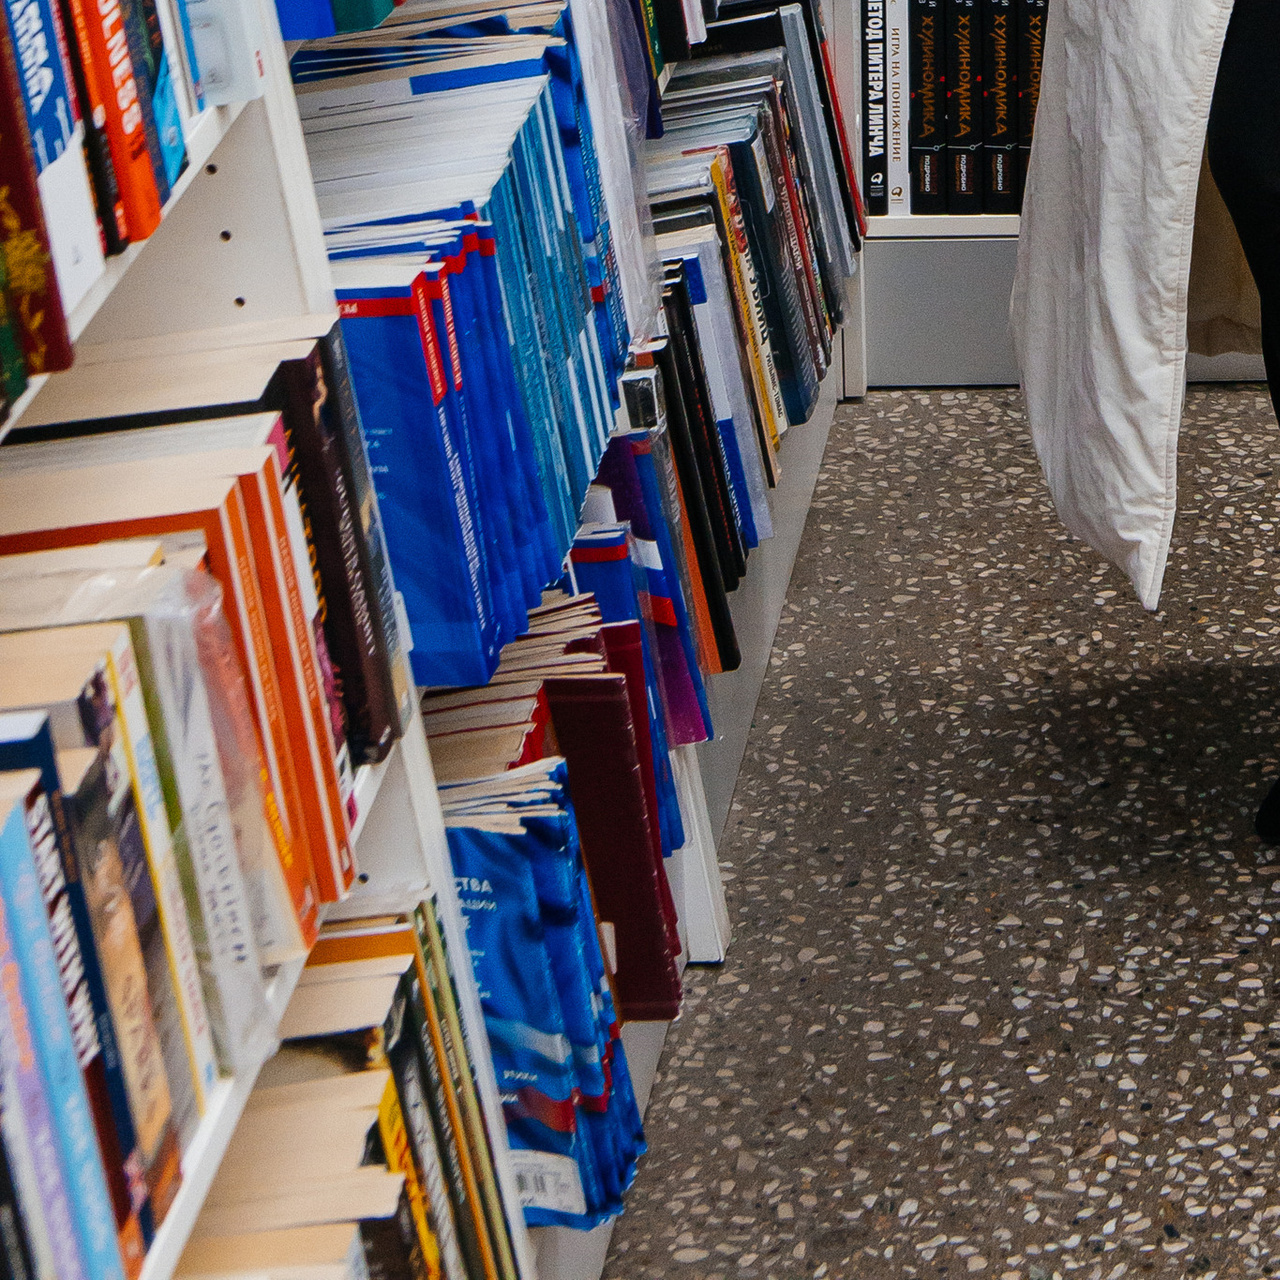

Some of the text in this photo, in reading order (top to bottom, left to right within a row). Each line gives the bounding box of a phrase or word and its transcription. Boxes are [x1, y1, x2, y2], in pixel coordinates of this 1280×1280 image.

[867, 43, 883, 101] ПИТЕРА
[891, 28, 902, 163] ИГРА НА ПОНИЖЕНИЕ
[868, 104, 884, 157] ЛИНЧА
